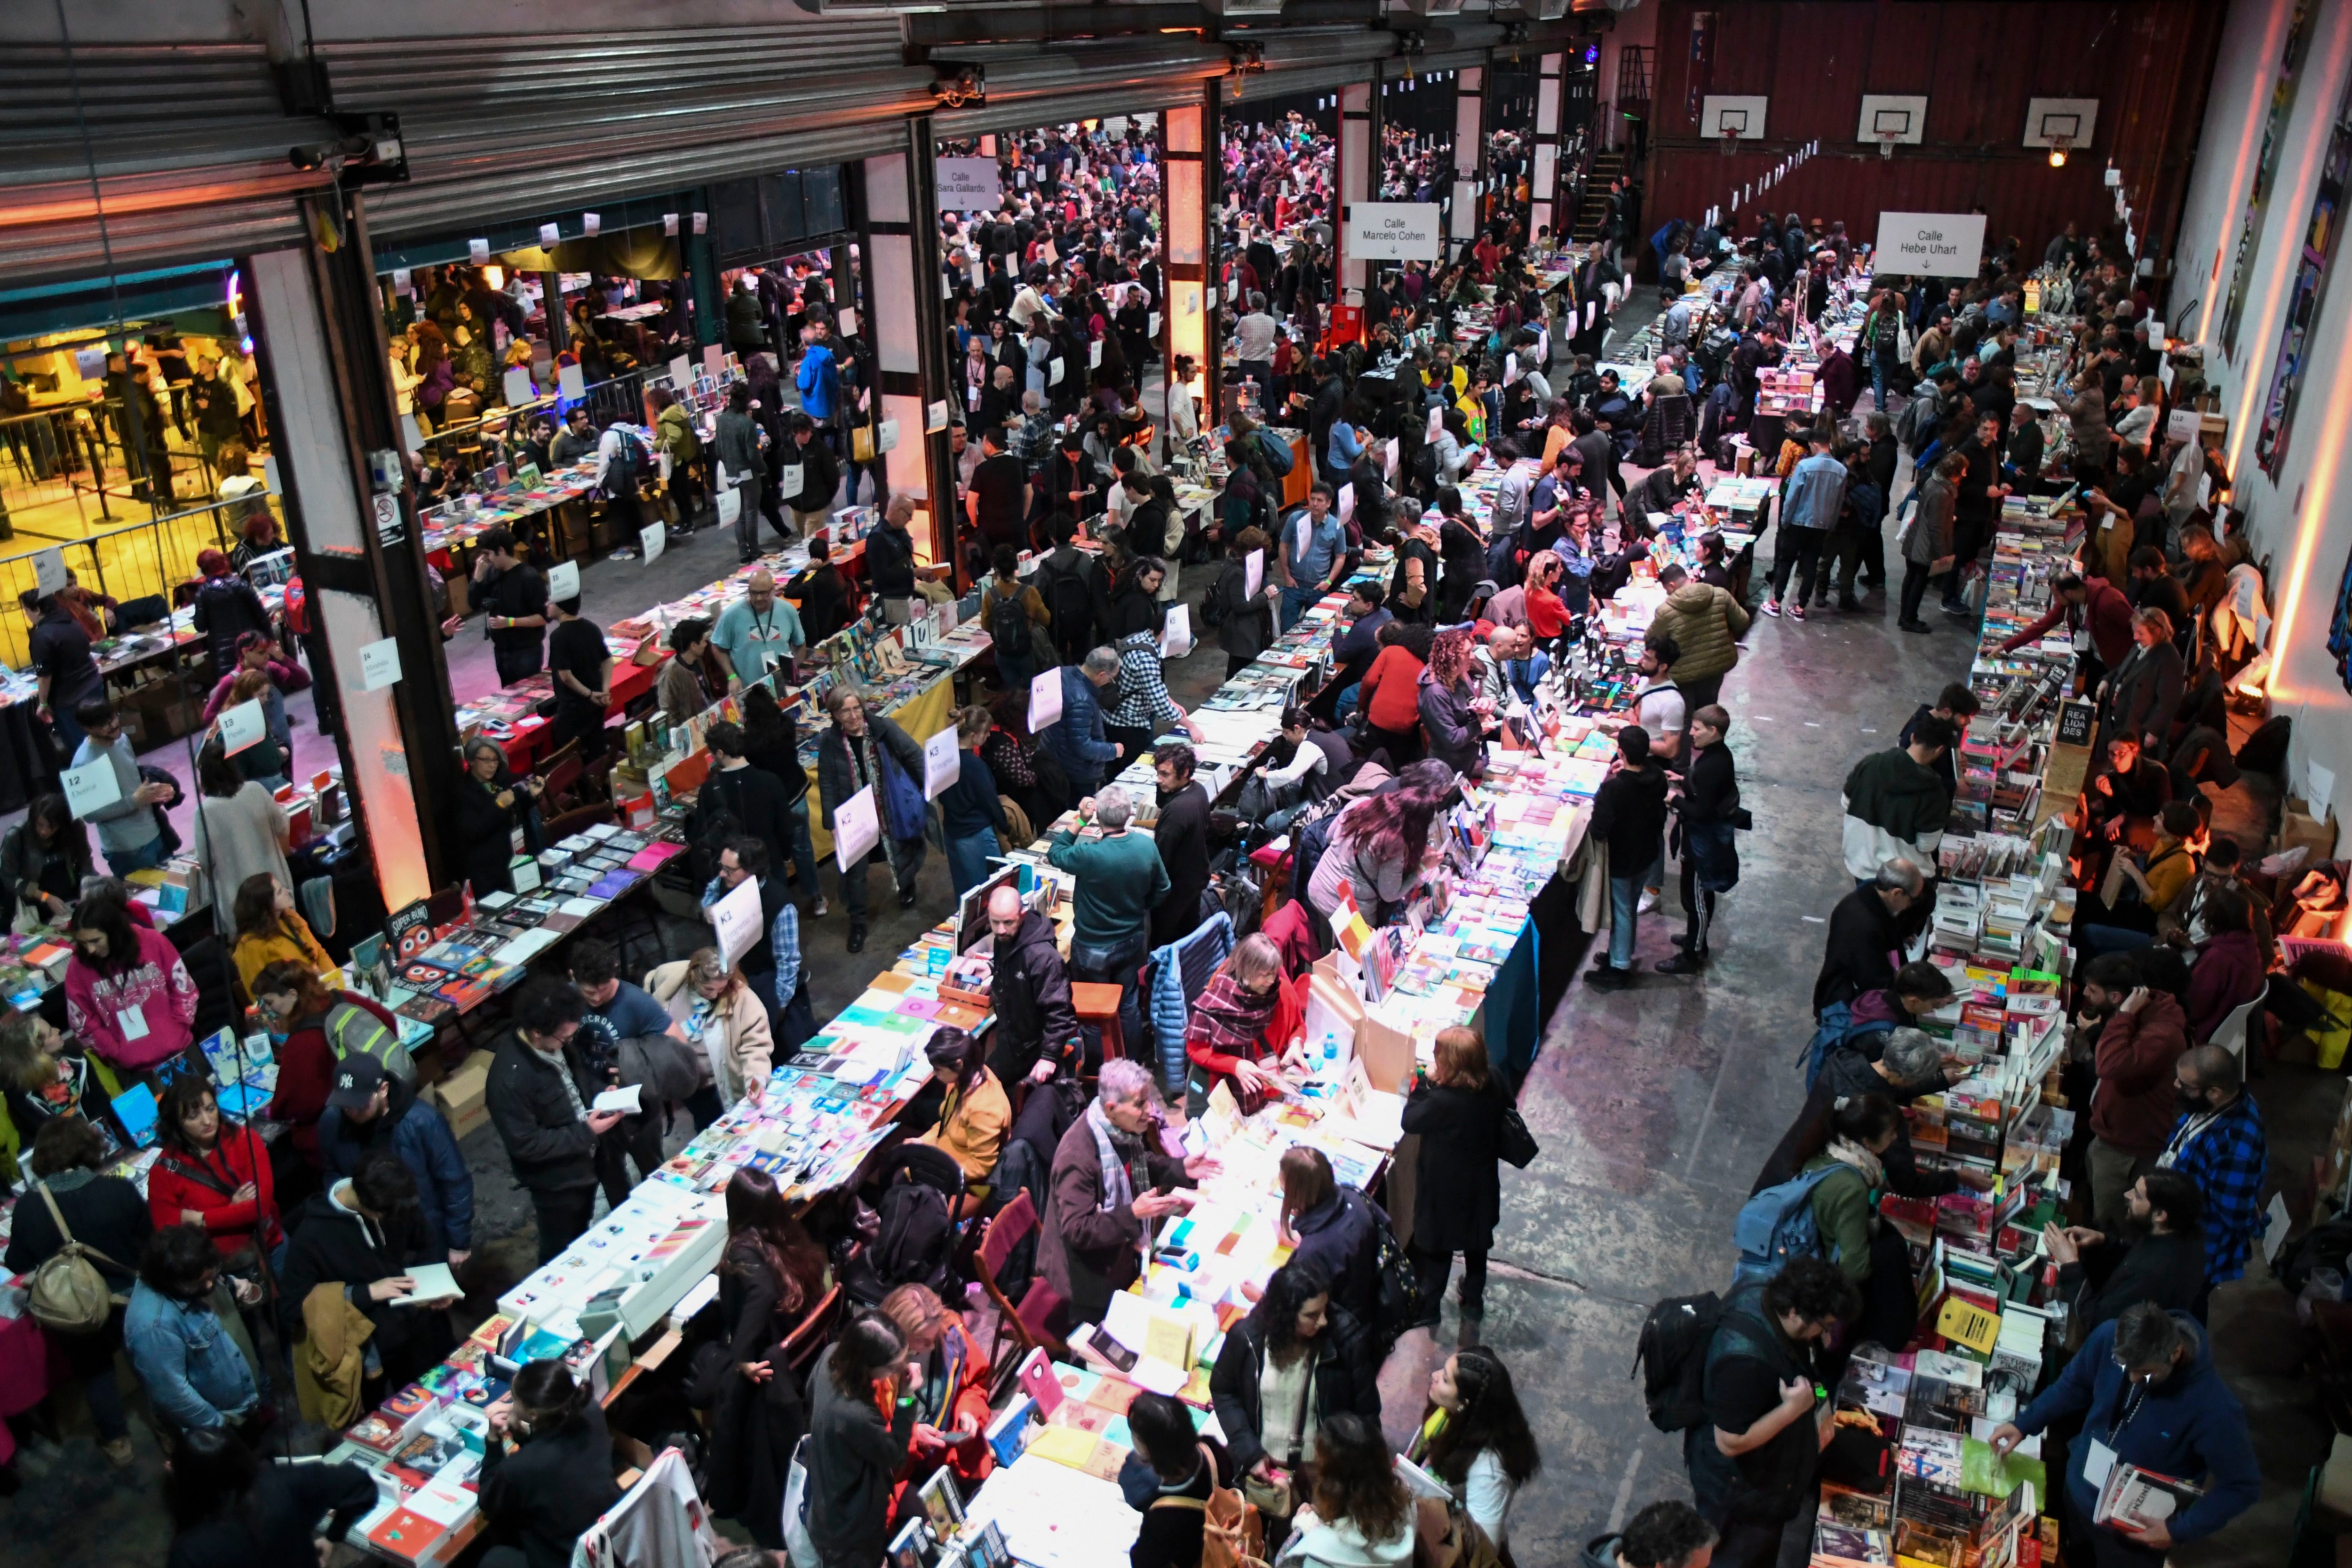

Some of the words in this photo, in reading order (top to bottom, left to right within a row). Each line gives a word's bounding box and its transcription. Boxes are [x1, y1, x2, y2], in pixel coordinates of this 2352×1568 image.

[952, 173, 969, 182] Calle
[938, 184, 954, 192] Sara
[956, 184, 985, 193] Gallardo
[1384, 219, 1405, 228] Calle
[1363, 231, 1396, 240] Marcelo
[1398, 231, 1425, 240] Cohen
[1917, 231, 1942, 241] Calle
[1900, 243, 1926, 254] Hebe
[1930, 244, 1956, 255] Uhart
[364, 653, 371, 661] I4
[1036, 685, 1043, 693] K4
[2067, 710, 2086, 720] REA
[224, 718, 234, 729] I3
[2064, 718, 2086, 729] LIDA
[2062, 727, 2082, 736] DES
[930, 746, 939, 758] K3
[69, 776, 81, 786] I2
[842, 813, 851, 827] K2
[721, 911, 732, 925] K1
[1997, 1354, 2037, 1370] OCTUBRE
